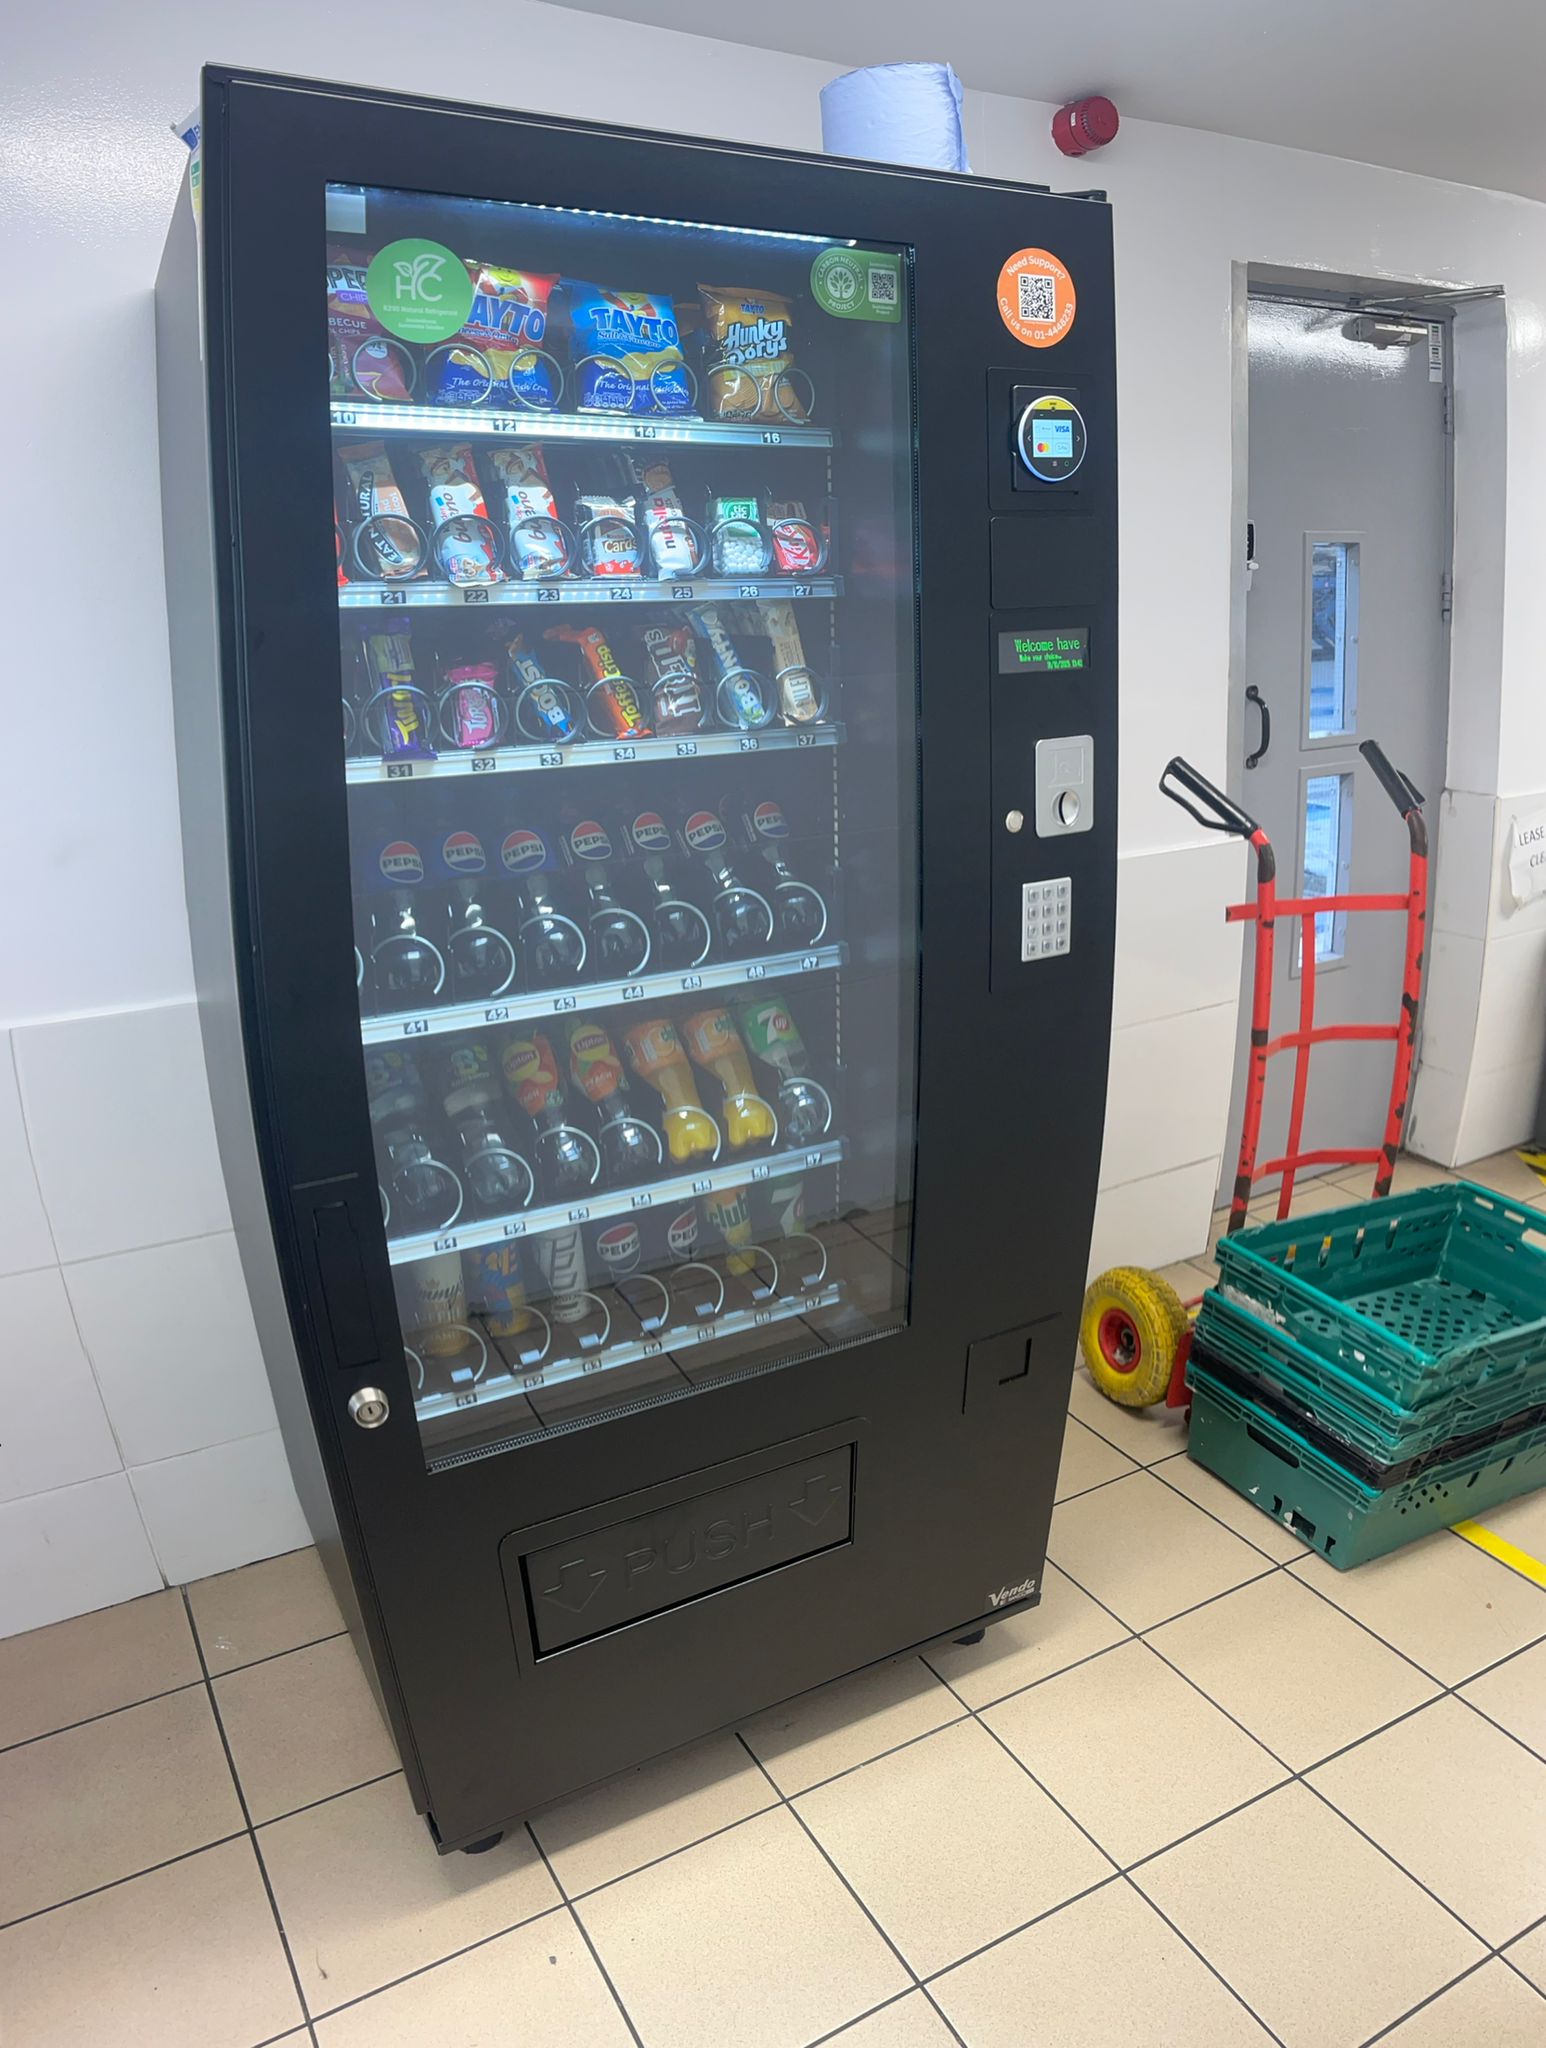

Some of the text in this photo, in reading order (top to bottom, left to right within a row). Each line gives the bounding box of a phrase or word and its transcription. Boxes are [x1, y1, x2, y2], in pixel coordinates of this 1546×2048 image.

[1006, 255, 1066, 280] Need Support?
[340, 292, 368, 302] CHIP
[741, 303, 765, 315] TAYTO
[827, 299, 855, 311] PROJECT
[464, 294, 546, 342] AYTO
[1000, 297, 1013, 319] Call
[1010, 318, 1021, 330] us
[1021, 327, 1032, 337] on
[328, 317, 367, 330] BECUE
[589, 306, 679, 347] TAYTO
[723, 318, 784, 350] Hunky
[333, 411, 355, 424] 10
[494, 420, 515, 432] 12
[635, 426, 655, 438] 14
[1055, 425, 1070, 433] VISA
[763, 432, 780, 443] 16
[733, 504, 748, 513] tic
[360, 473, 397, 562] EAT NTURAL
[466, 590, 487, 602] 22
[538, 589, 559, 600] 23
[611, 588, 631, 600] 24
[673, 588, 692, 598] 25
[741, 586, 758, 597] 26
[794, 586, 811, 596] 27
[383, 592, 405, 603] 21
[1014, 636, 1080, 653] Welcome have
[741, 739, 758, 750] 36
[799, 735, 814, 745] 37
[616, 749, 635, 759] 34
[678, 744, 696, 755] 35
[474, 759, 495, 771] 32
[541, 753, 562, 765] 33
[389, 765, 412, 777] 31
[635, 825, 665, 839] PEPS
[1518, 825, 1545, 847] LEASE
[504, 843, 543, 861] PEPSI
[1529, 851, 1546, 868] CLE
[802, 957, 818, 968] 47
[624, 986, 643, 998] 44
[487, 1009, 508, 1020] 42
[600, 1237, 639, 1256] PEPS
[624, 1503, 777, 1592] PUSH
[988, 1579, 1036, 1607] Vendo
